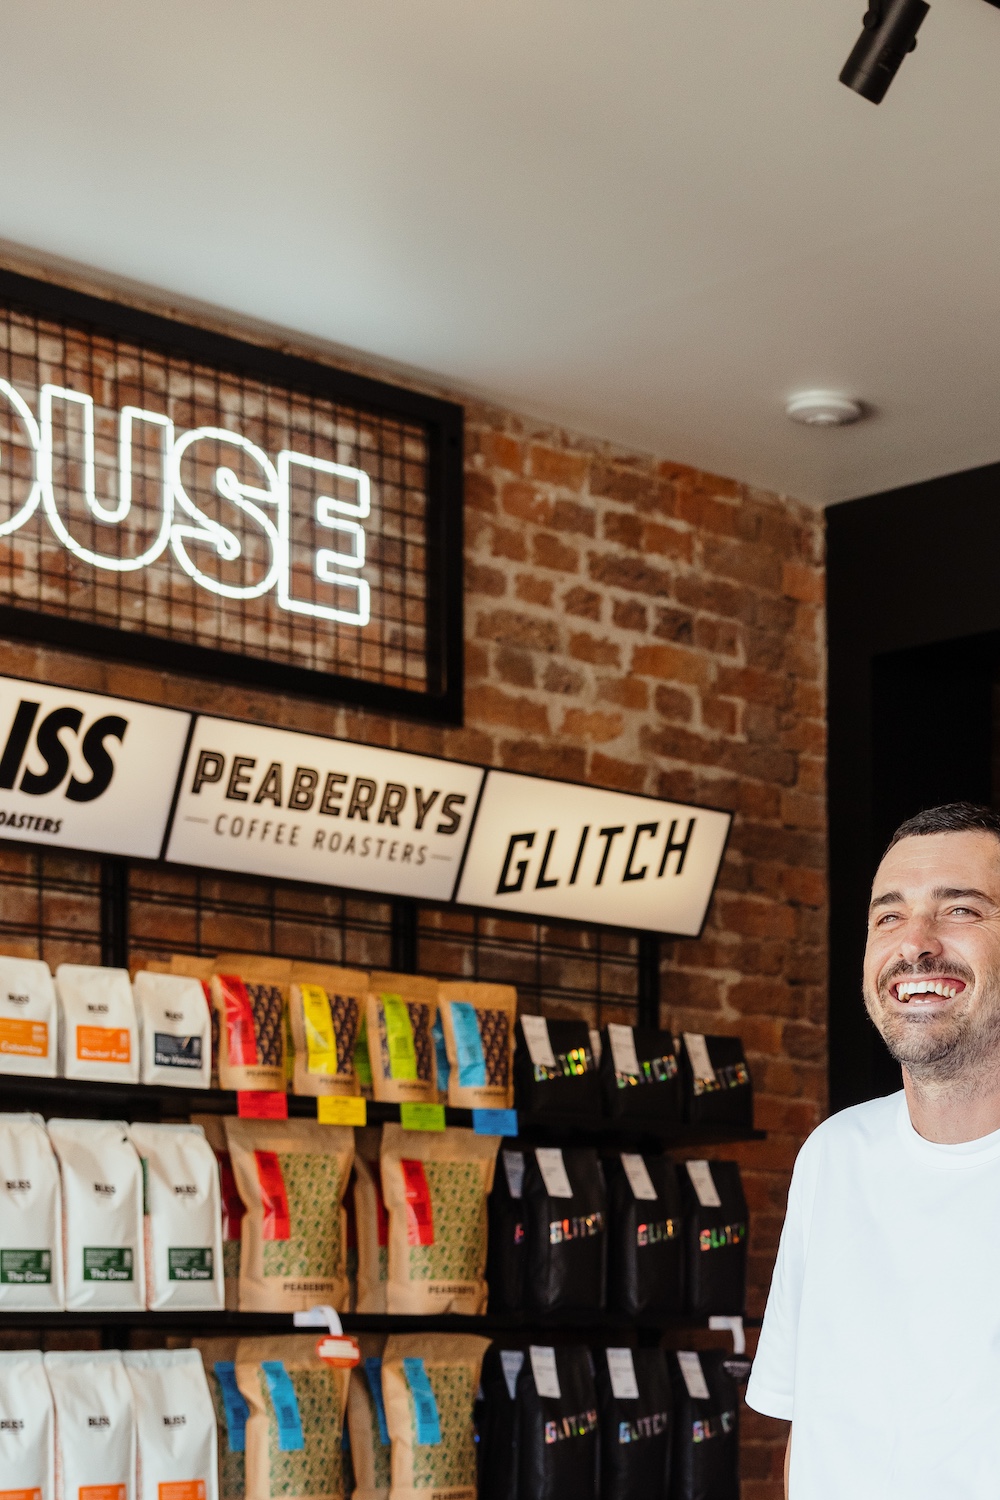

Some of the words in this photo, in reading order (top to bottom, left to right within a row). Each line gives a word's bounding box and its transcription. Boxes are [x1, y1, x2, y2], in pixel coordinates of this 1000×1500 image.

[192, 751, 466, 836] PEABERRYS
[214, 815, 299, 848] COFFEE
[313, 825, 429, 866] ROASTERS
[495, 818, 697, 896] GLITCH
